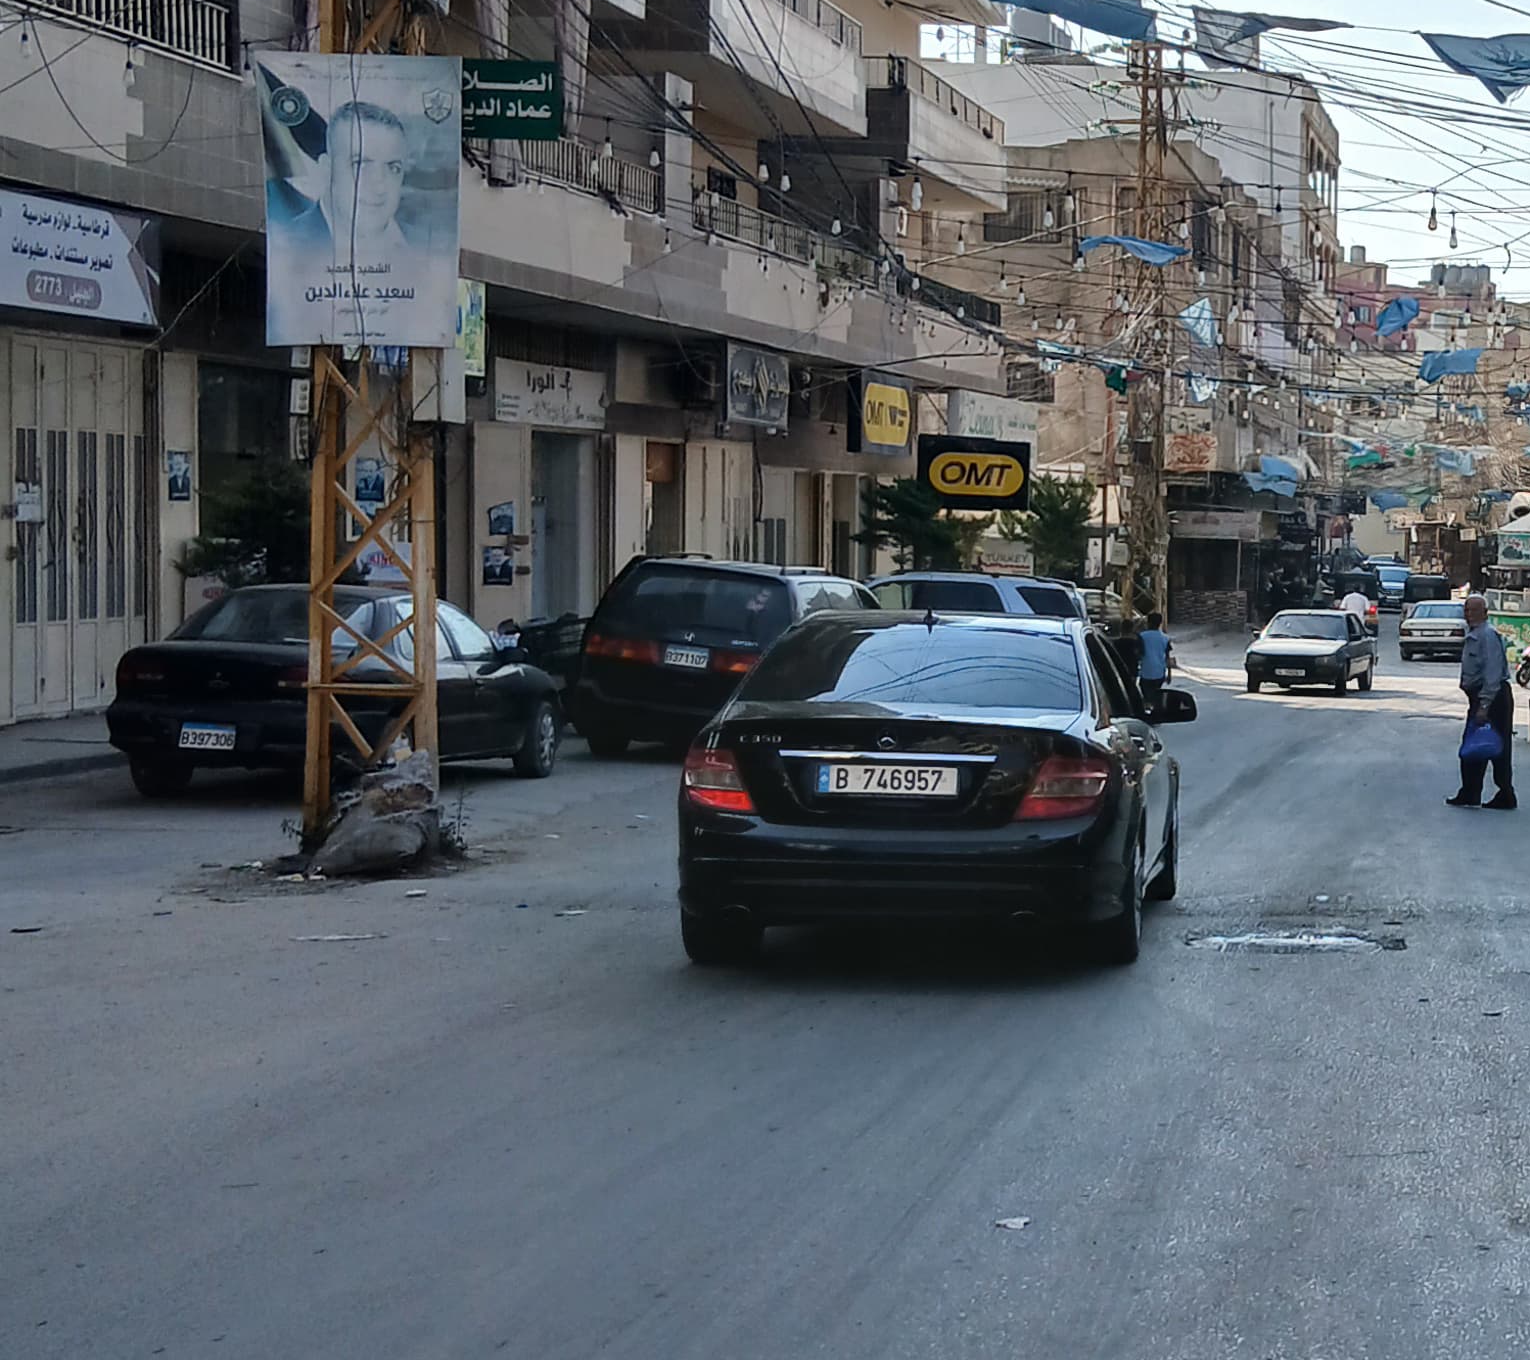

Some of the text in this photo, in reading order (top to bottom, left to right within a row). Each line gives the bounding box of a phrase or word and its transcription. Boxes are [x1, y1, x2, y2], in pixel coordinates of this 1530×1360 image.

[463, 69, 553, 92] الصلا
[463, 97, 553, 121] عماد الدي
[22, 202, 52, 226] مدرسية
[78, 214, 111, 240] قرطاسية
[89, 253, 114, 272] تصوير
[34, 274, 63, 296] 2773
[304, 281, 343, 302] الدين
[374, 286, 415, 303] سعيد
[940, 460, 1014, 488] OMT
[835, 767, 944, 792] B 746957
